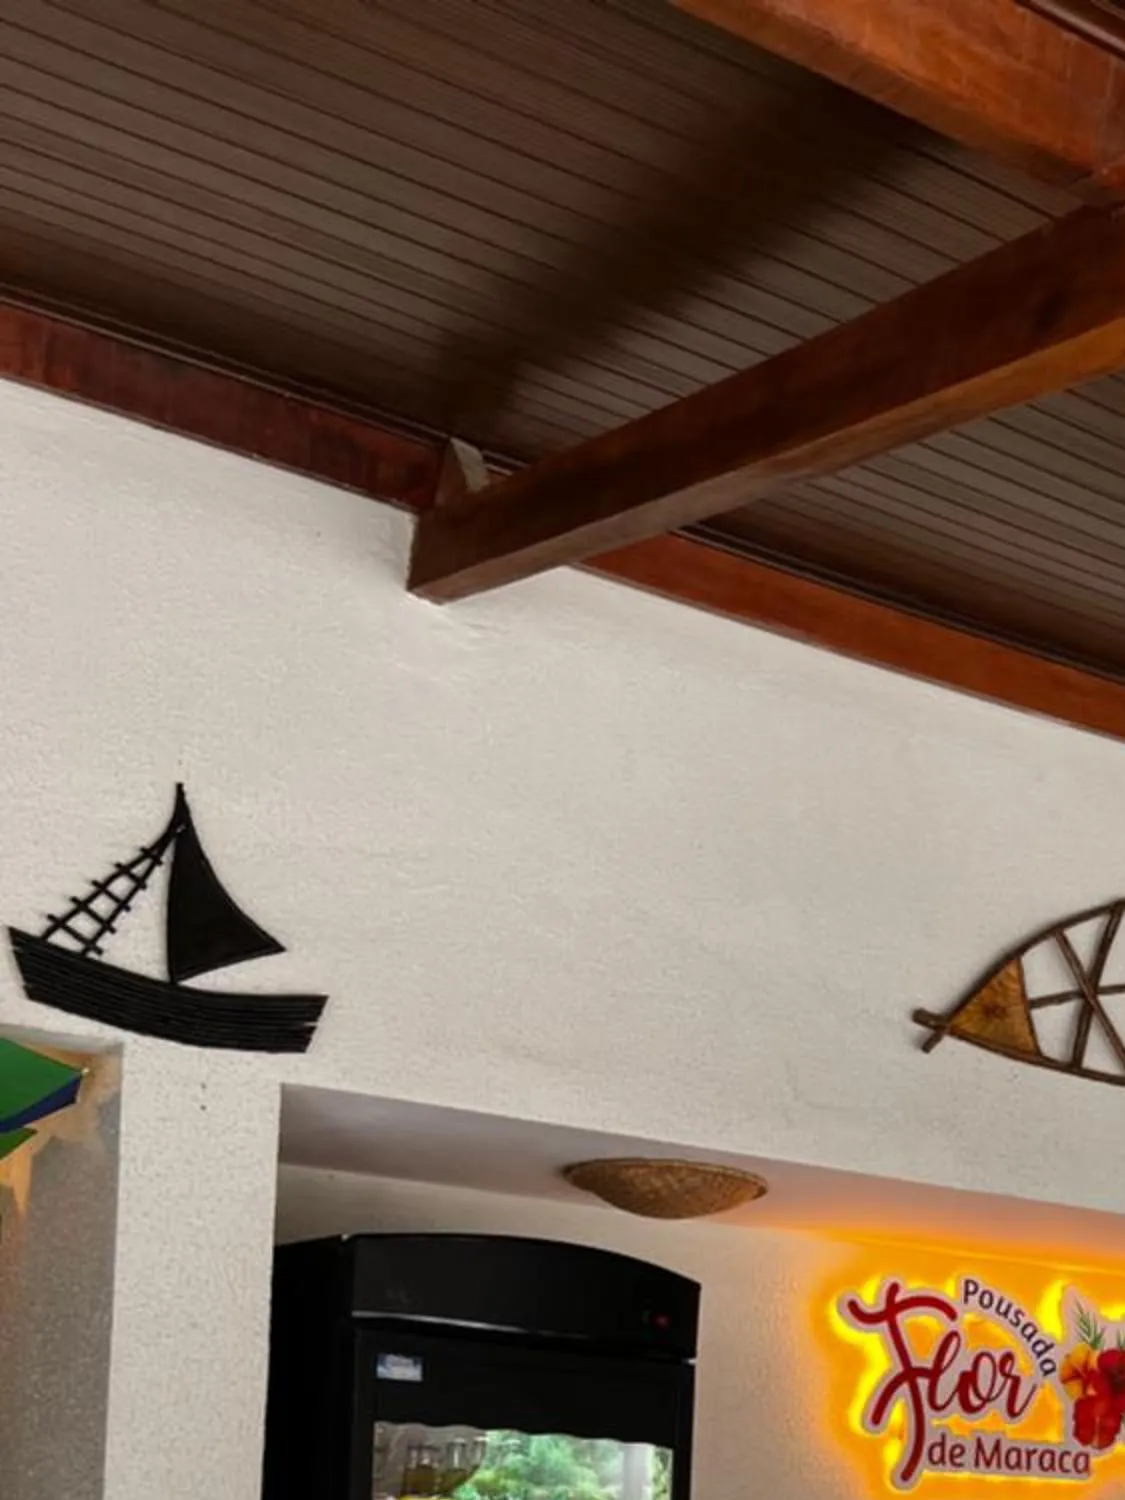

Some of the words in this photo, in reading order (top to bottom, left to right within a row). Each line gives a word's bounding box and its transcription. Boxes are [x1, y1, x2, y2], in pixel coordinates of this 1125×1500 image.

[963, 1278, 1058, 1377] Pousada
[848, 1281, 1038, 1481] Flor
[927, 1432, 965, 1468] de
[973, 1436, 1091, 1475] Maraca
